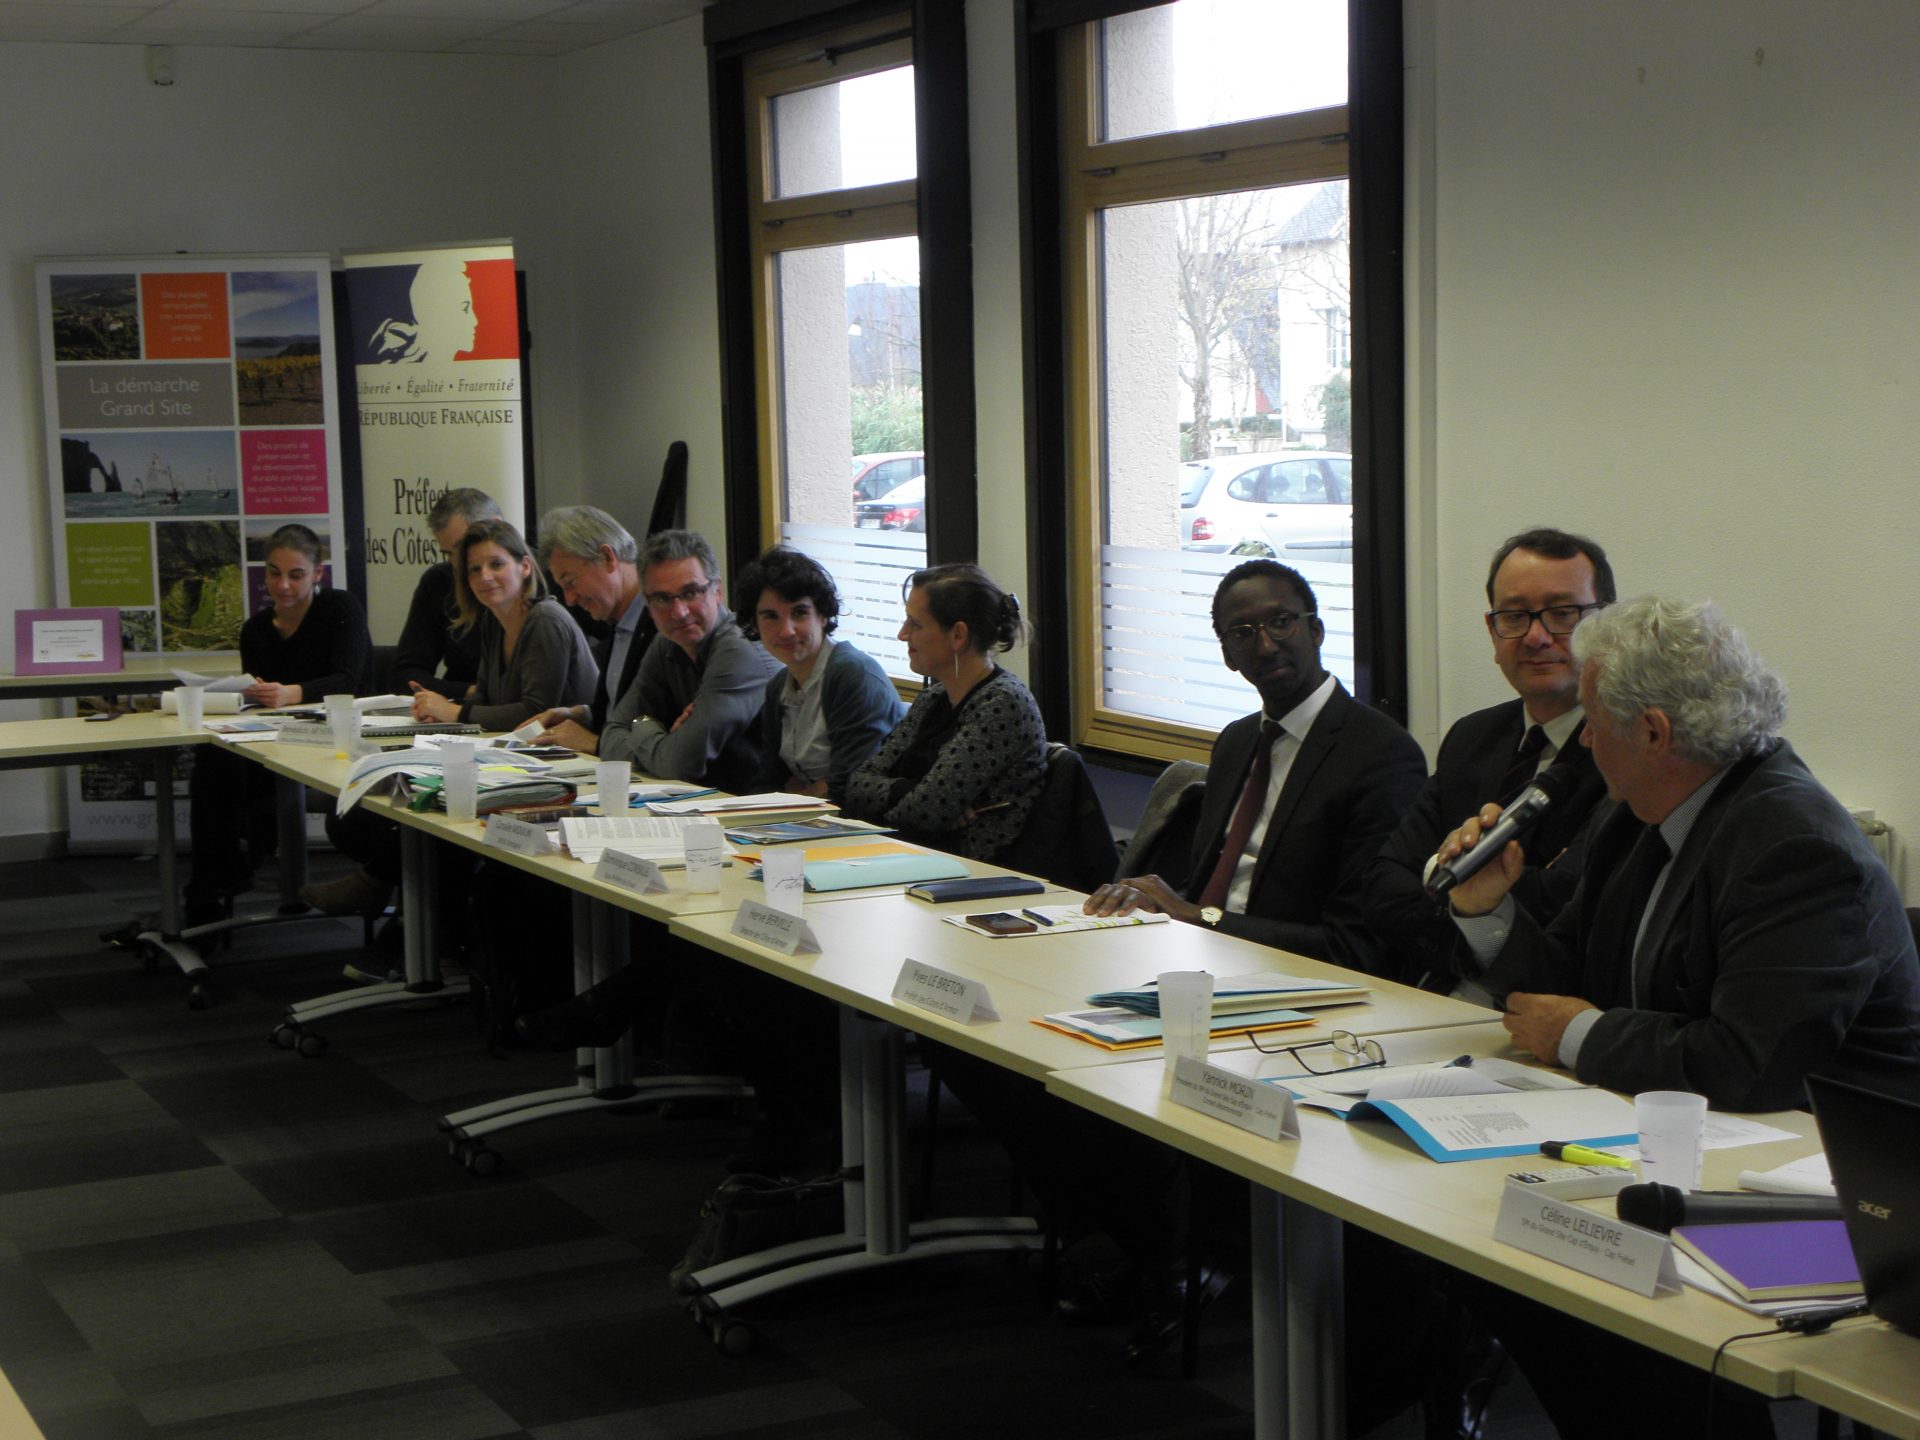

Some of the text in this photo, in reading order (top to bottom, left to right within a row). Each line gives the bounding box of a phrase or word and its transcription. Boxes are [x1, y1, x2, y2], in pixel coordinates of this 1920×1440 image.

[90, 375, 200, 393] La démarche
[406, 376, 444, 398] Égalité
[458, 378, 514, 392] Fraternité
[100, 399, 192, 416] Grand Site
[365, 527, 439, 565] des Côtes
[937, 977, 968, 997] BRETON
[1858, 1200, 1891, 1220] acer
[1540, 1205, 1623, 1247] Céline LELIEVRE
